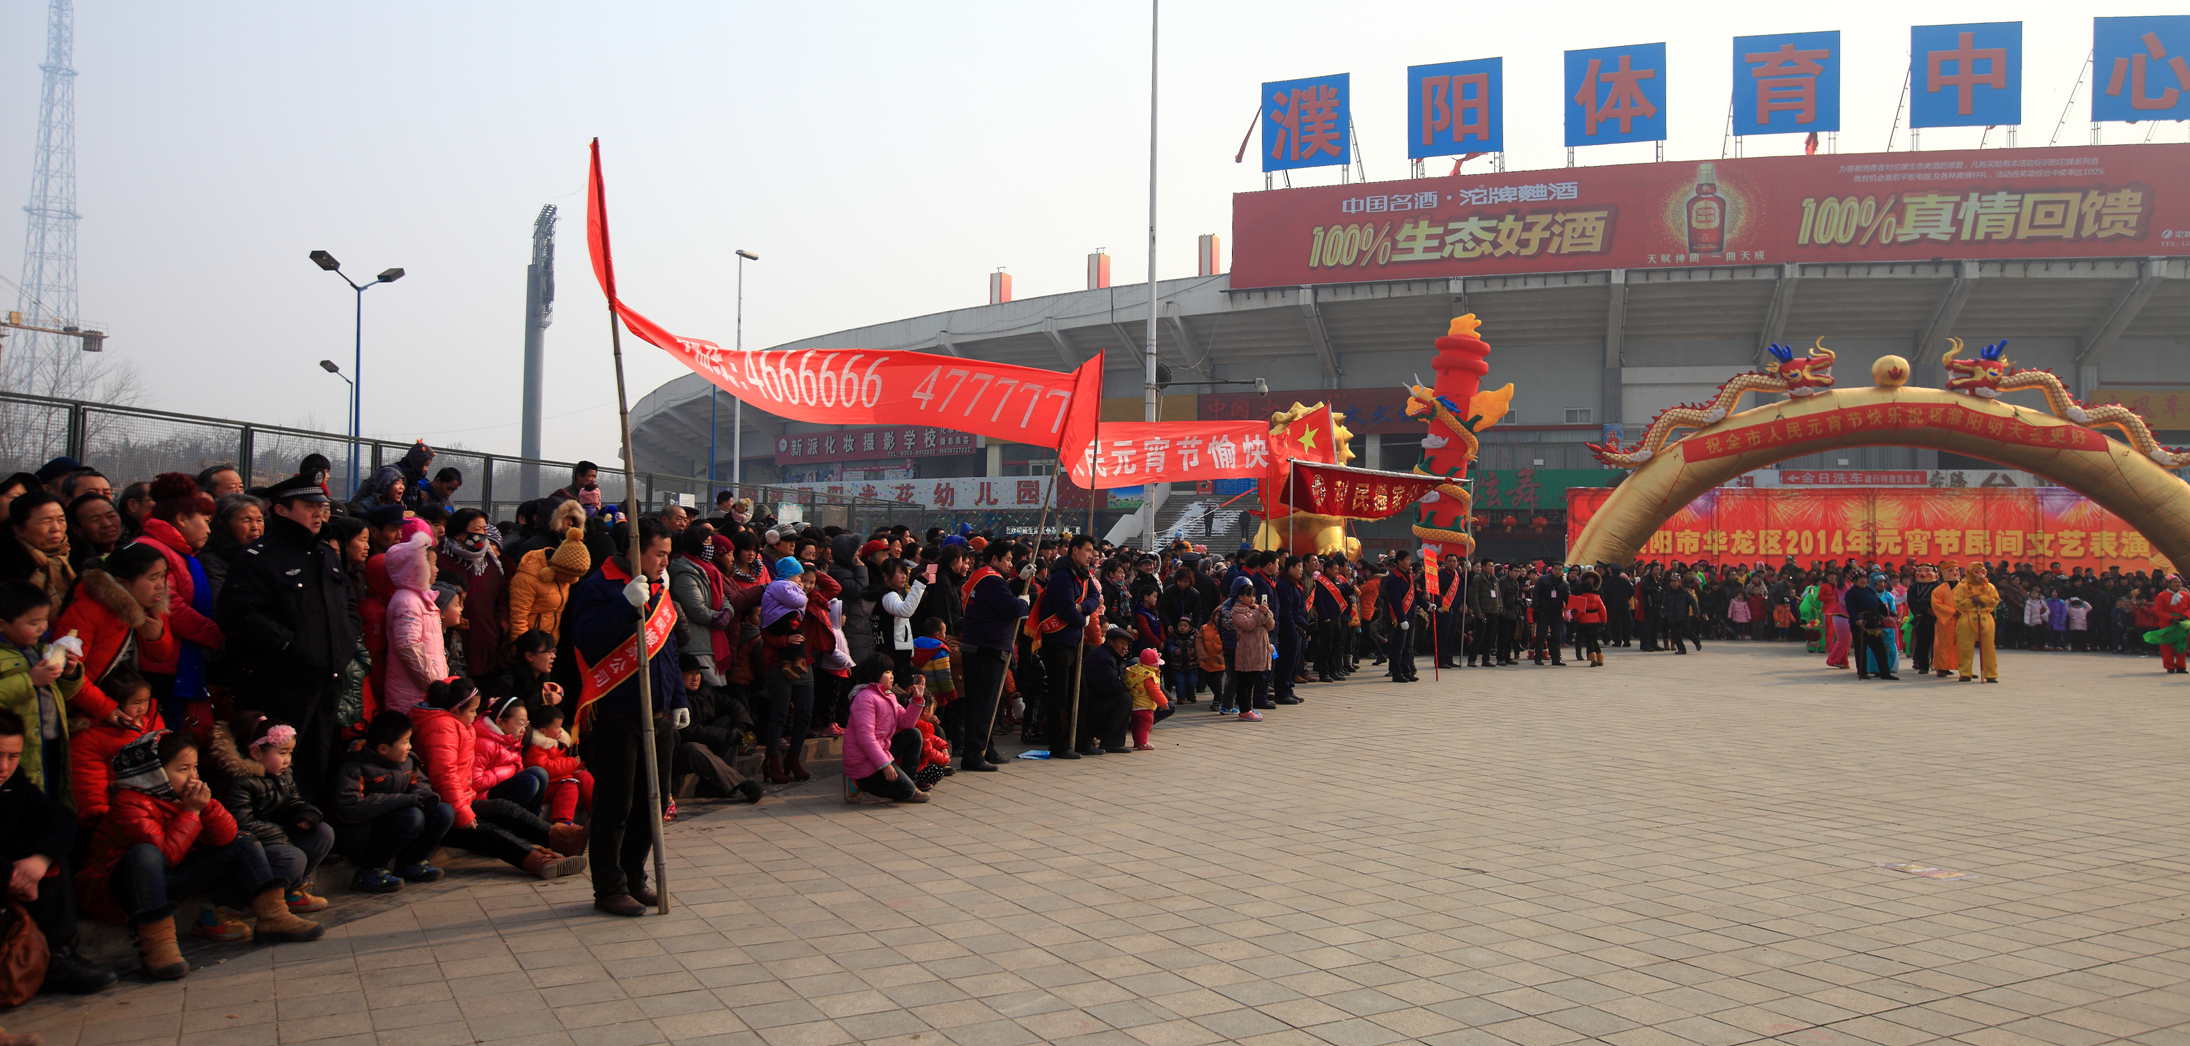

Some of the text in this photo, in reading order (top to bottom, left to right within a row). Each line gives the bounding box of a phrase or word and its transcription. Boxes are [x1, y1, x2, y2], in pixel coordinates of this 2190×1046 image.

[1270, 32, 2190, 160] 濮阳体育中心
[1308, 210, 1609, 268] 100%生态好酒
[1797, 190, 2143, 246] 100%真情回馈
[790, 428, 938, 457] 新派化妆摄影学校
[1641, 528, 2150, 560] 阳市华龙区2014年元宵节民间文艺表演
